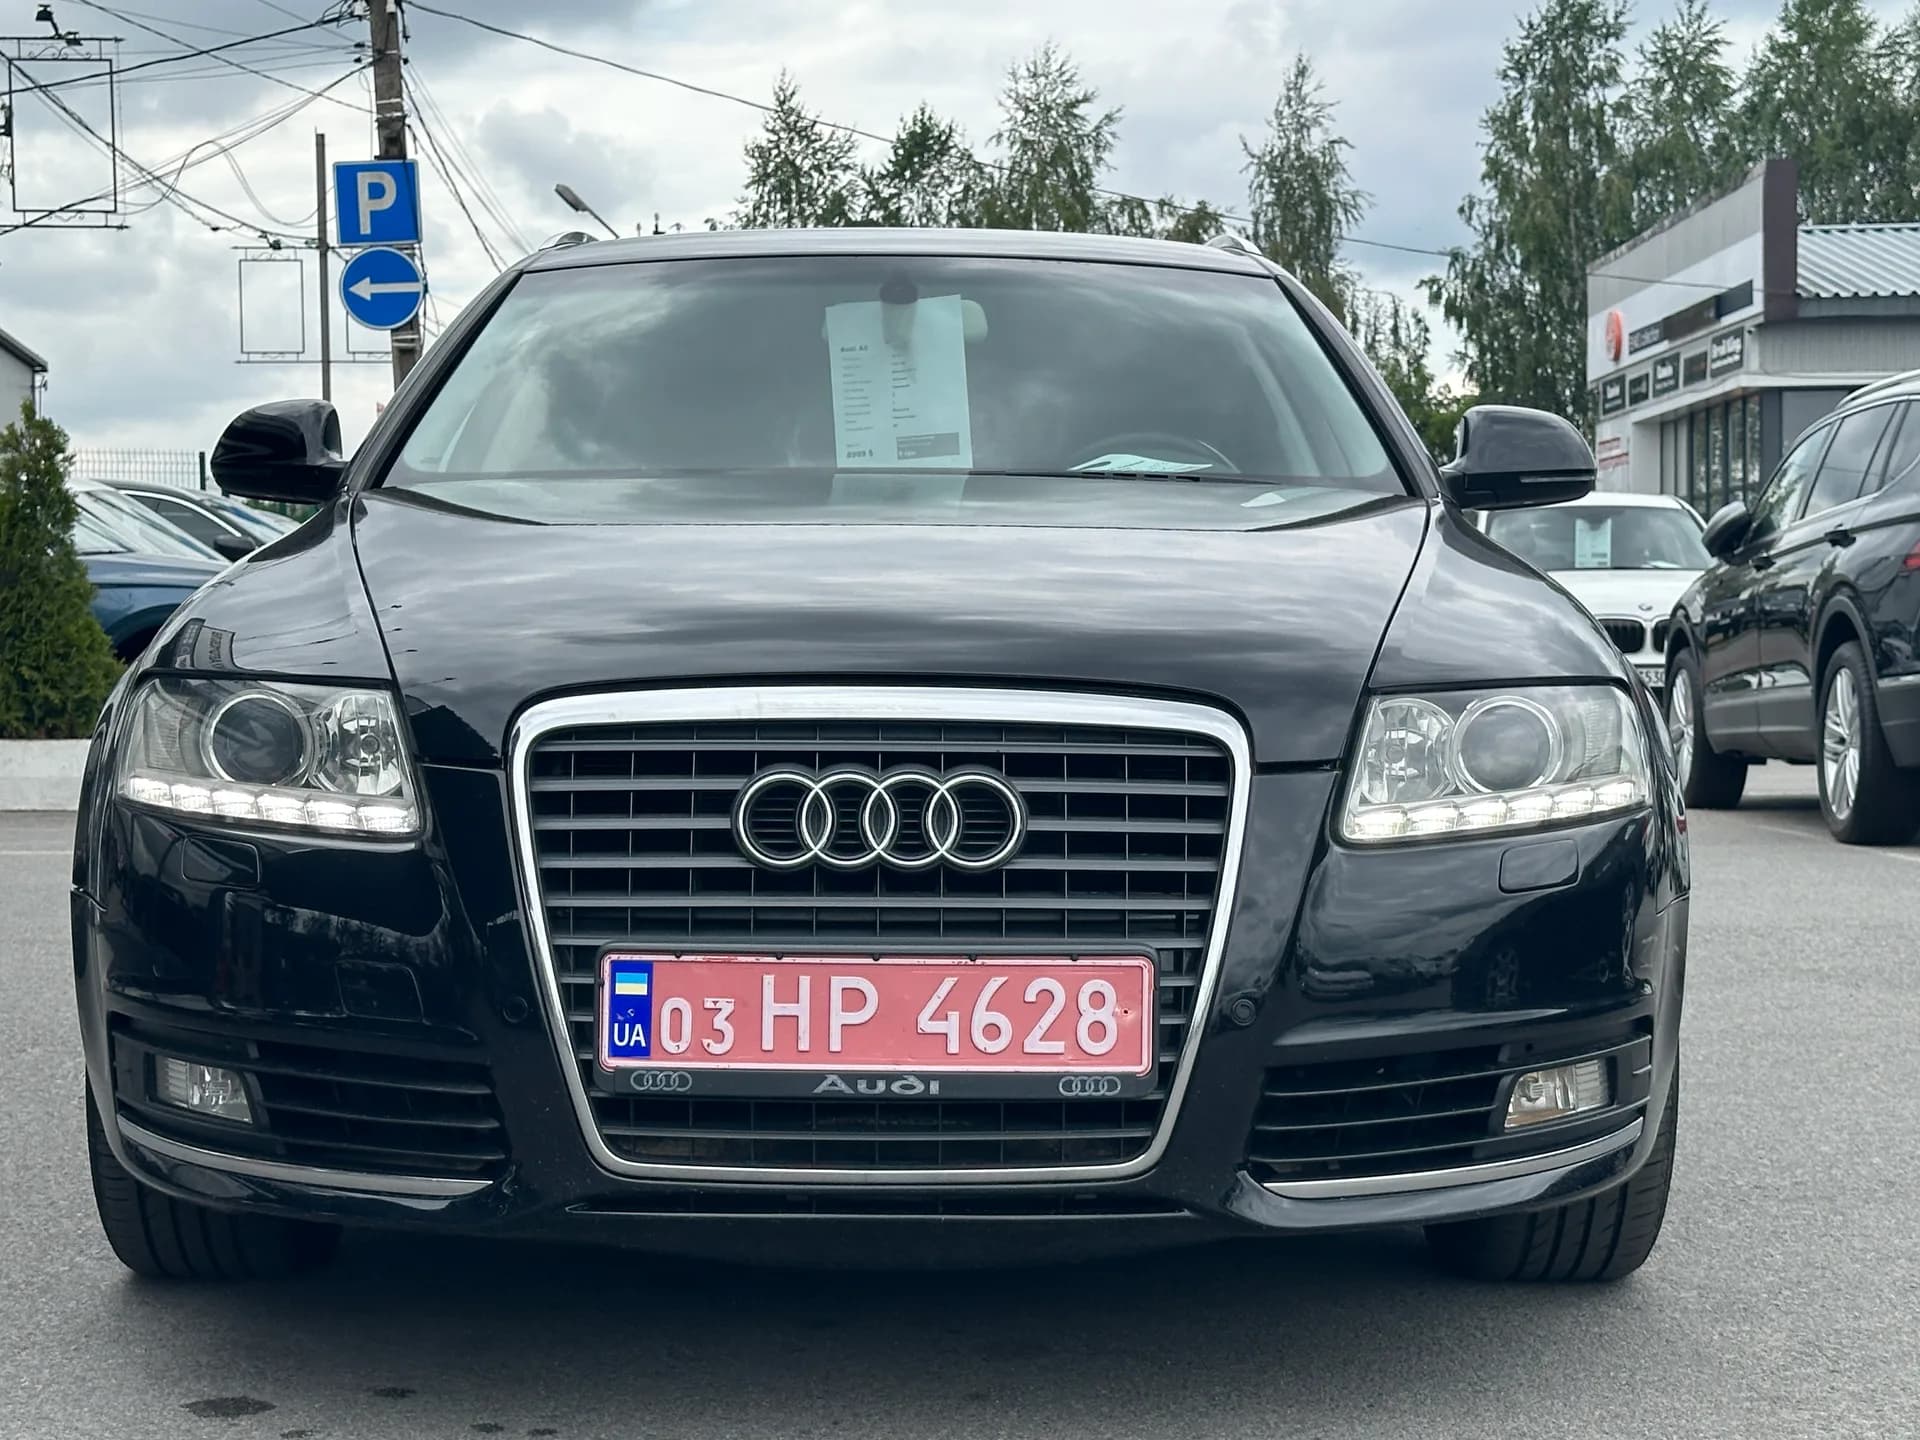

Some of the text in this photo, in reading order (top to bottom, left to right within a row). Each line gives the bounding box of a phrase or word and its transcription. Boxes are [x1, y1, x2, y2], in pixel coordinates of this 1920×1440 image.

[357, 171, 397, 235] P
[613, 1022, 647, 1047] UA
[660, 974, 1118, 1056] 03 HP 4628
[812, 1074, 940, 1095] Audi
